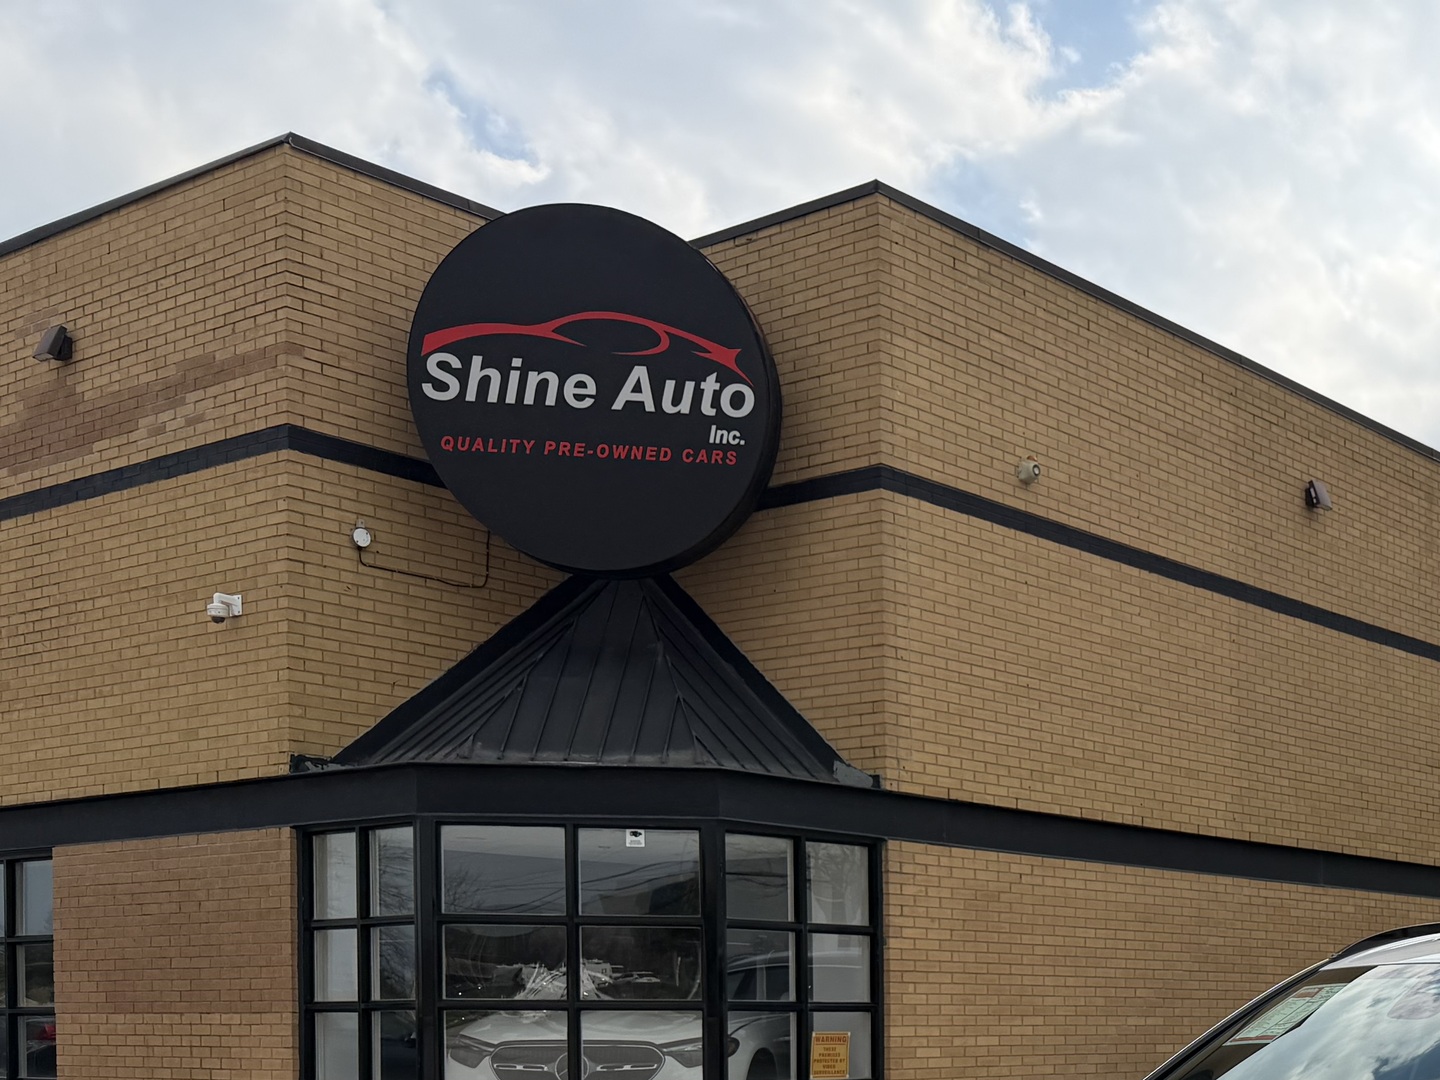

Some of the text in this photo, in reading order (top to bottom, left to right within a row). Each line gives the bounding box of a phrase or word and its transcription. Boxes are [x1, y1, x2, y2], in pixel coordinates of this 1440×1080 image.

[421, 352, 755, 418] Shine Auto
[709, 425, 746, 445] Inc.
[440, 436, 737, 465] QUALITY PRE-OWNED CARS
